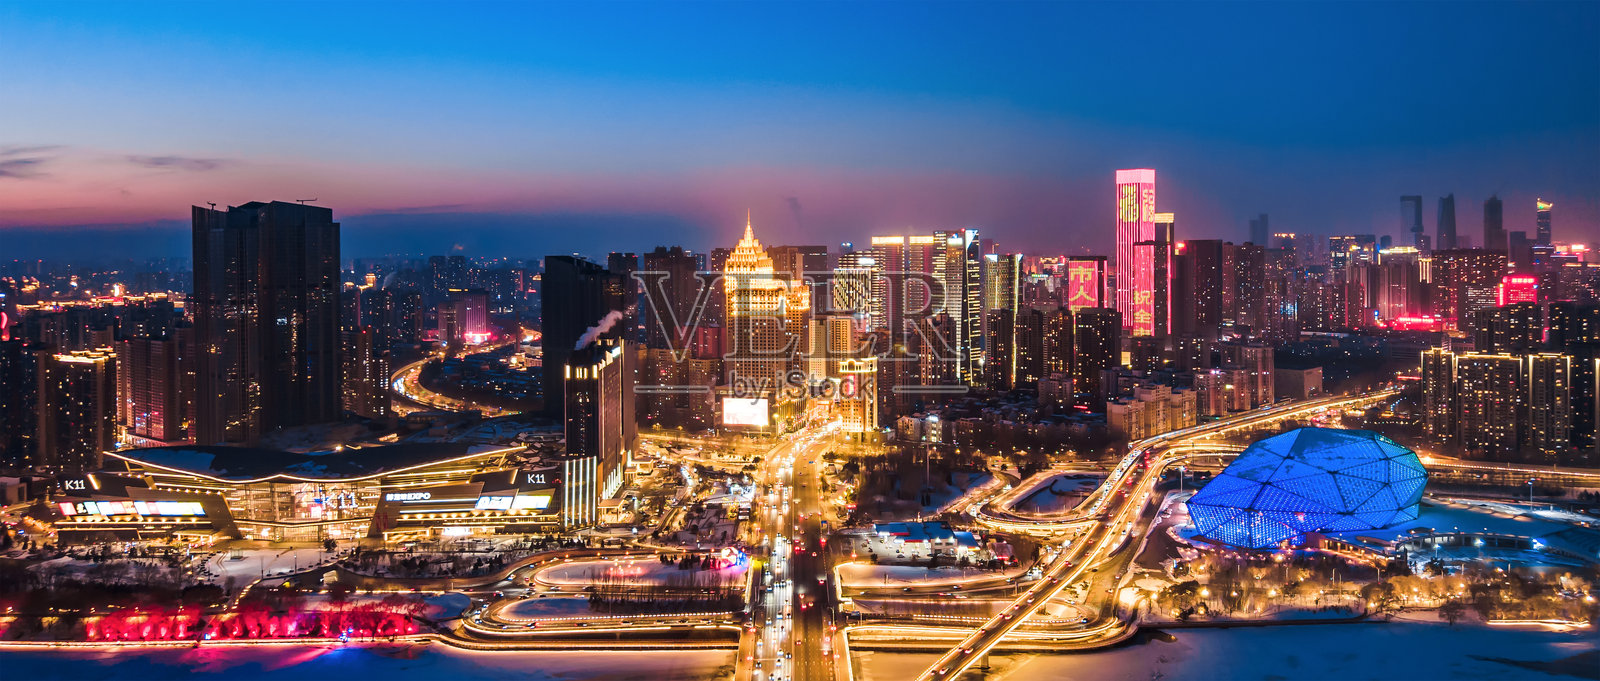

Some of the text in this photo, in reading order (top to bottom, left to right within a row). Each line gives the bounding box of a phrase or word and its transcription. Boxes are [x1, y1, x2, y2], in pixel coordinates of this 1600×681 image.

[1068, 265, 1097, 315] 市人
[65, 480, 86, 490] K11
[527, 474, 546, 484] K11
[321, 491, 359, 510] K11
